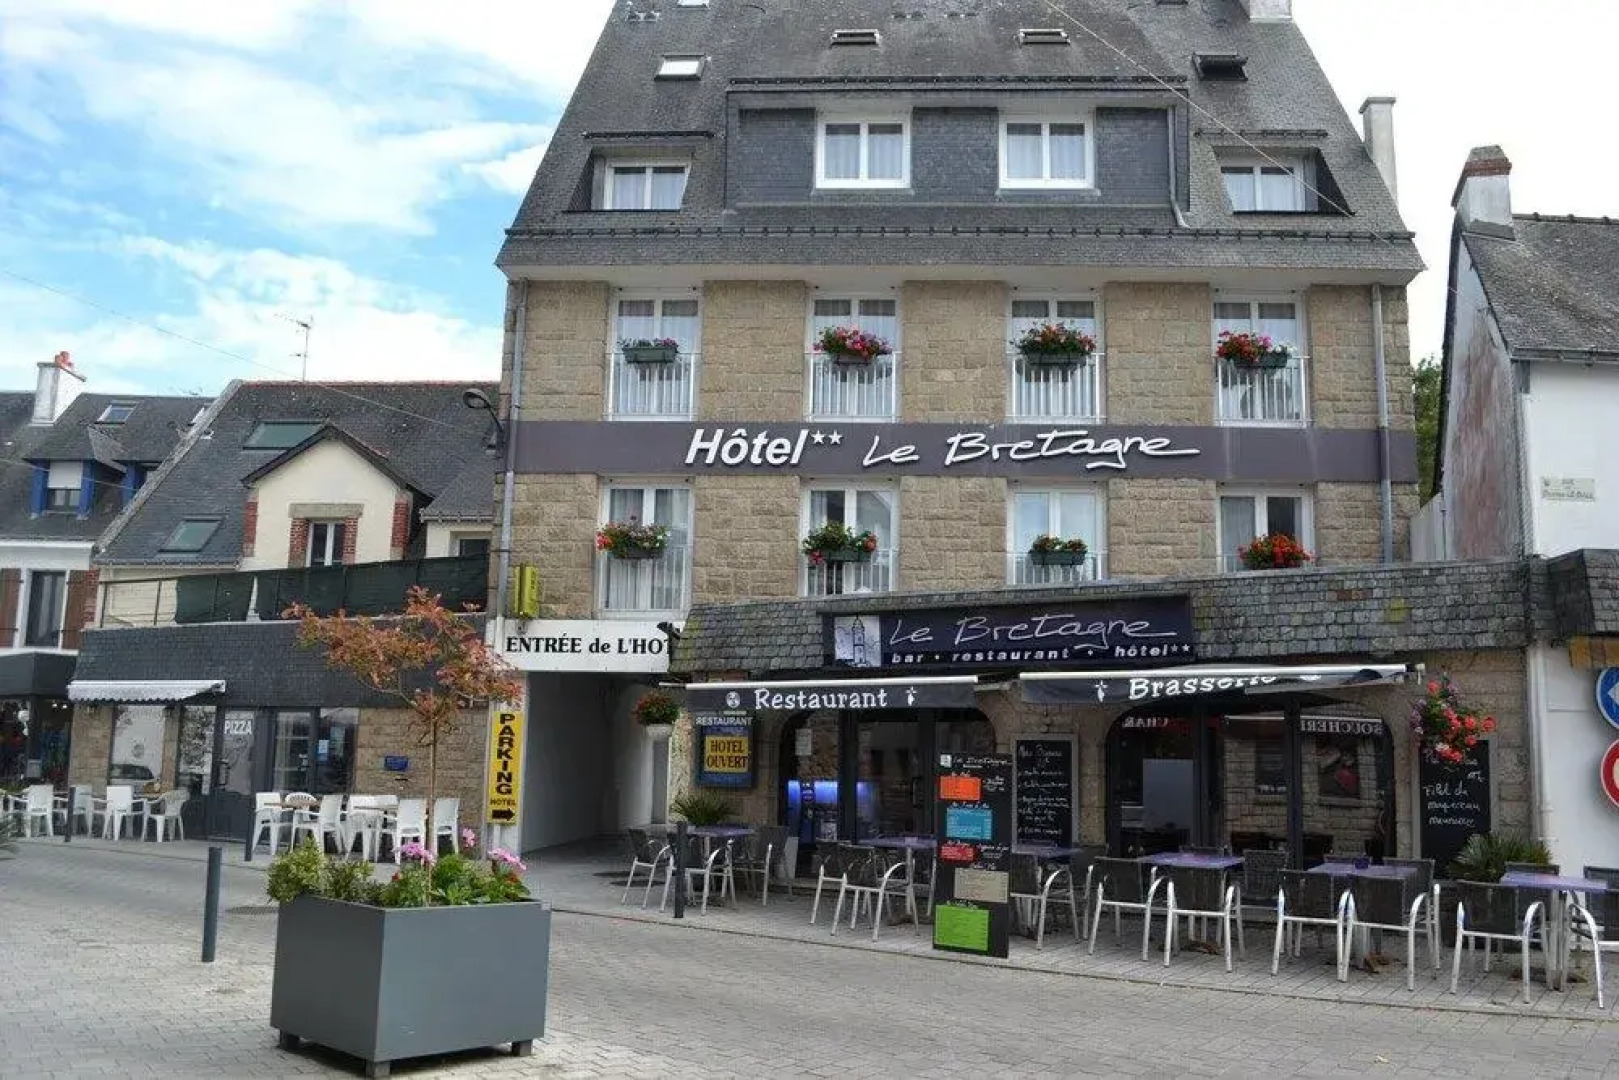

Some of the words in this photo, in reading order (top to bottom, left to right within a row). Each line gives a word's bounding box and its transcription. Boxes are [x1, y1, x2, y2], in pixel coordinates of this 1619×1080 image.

[685, 428, 809, 464] Hôtel
[862, 435, 920, 467] Le
[944, 430, 1200, 469] Bretagne
[889, 619, 934, 646] Le
[954, 613, 1178, 650] Bretagne
[506, 633, 582, 653] ENTRÉE
[588, 641, 611, 654] de
[892, 653, 924, 663] bar
[952, 648, 1070, 662] restaurant
[1114, 643, 1168, 657] hôtel
[753, 688, 888, 710] Restaurant
[224, 719, 252, 735] PIZZA
[695, 716, 753, 726] RESTAURANT
[496, 713, 516, 796] PARKING
[710, 739, 744, 754] HOTEL
